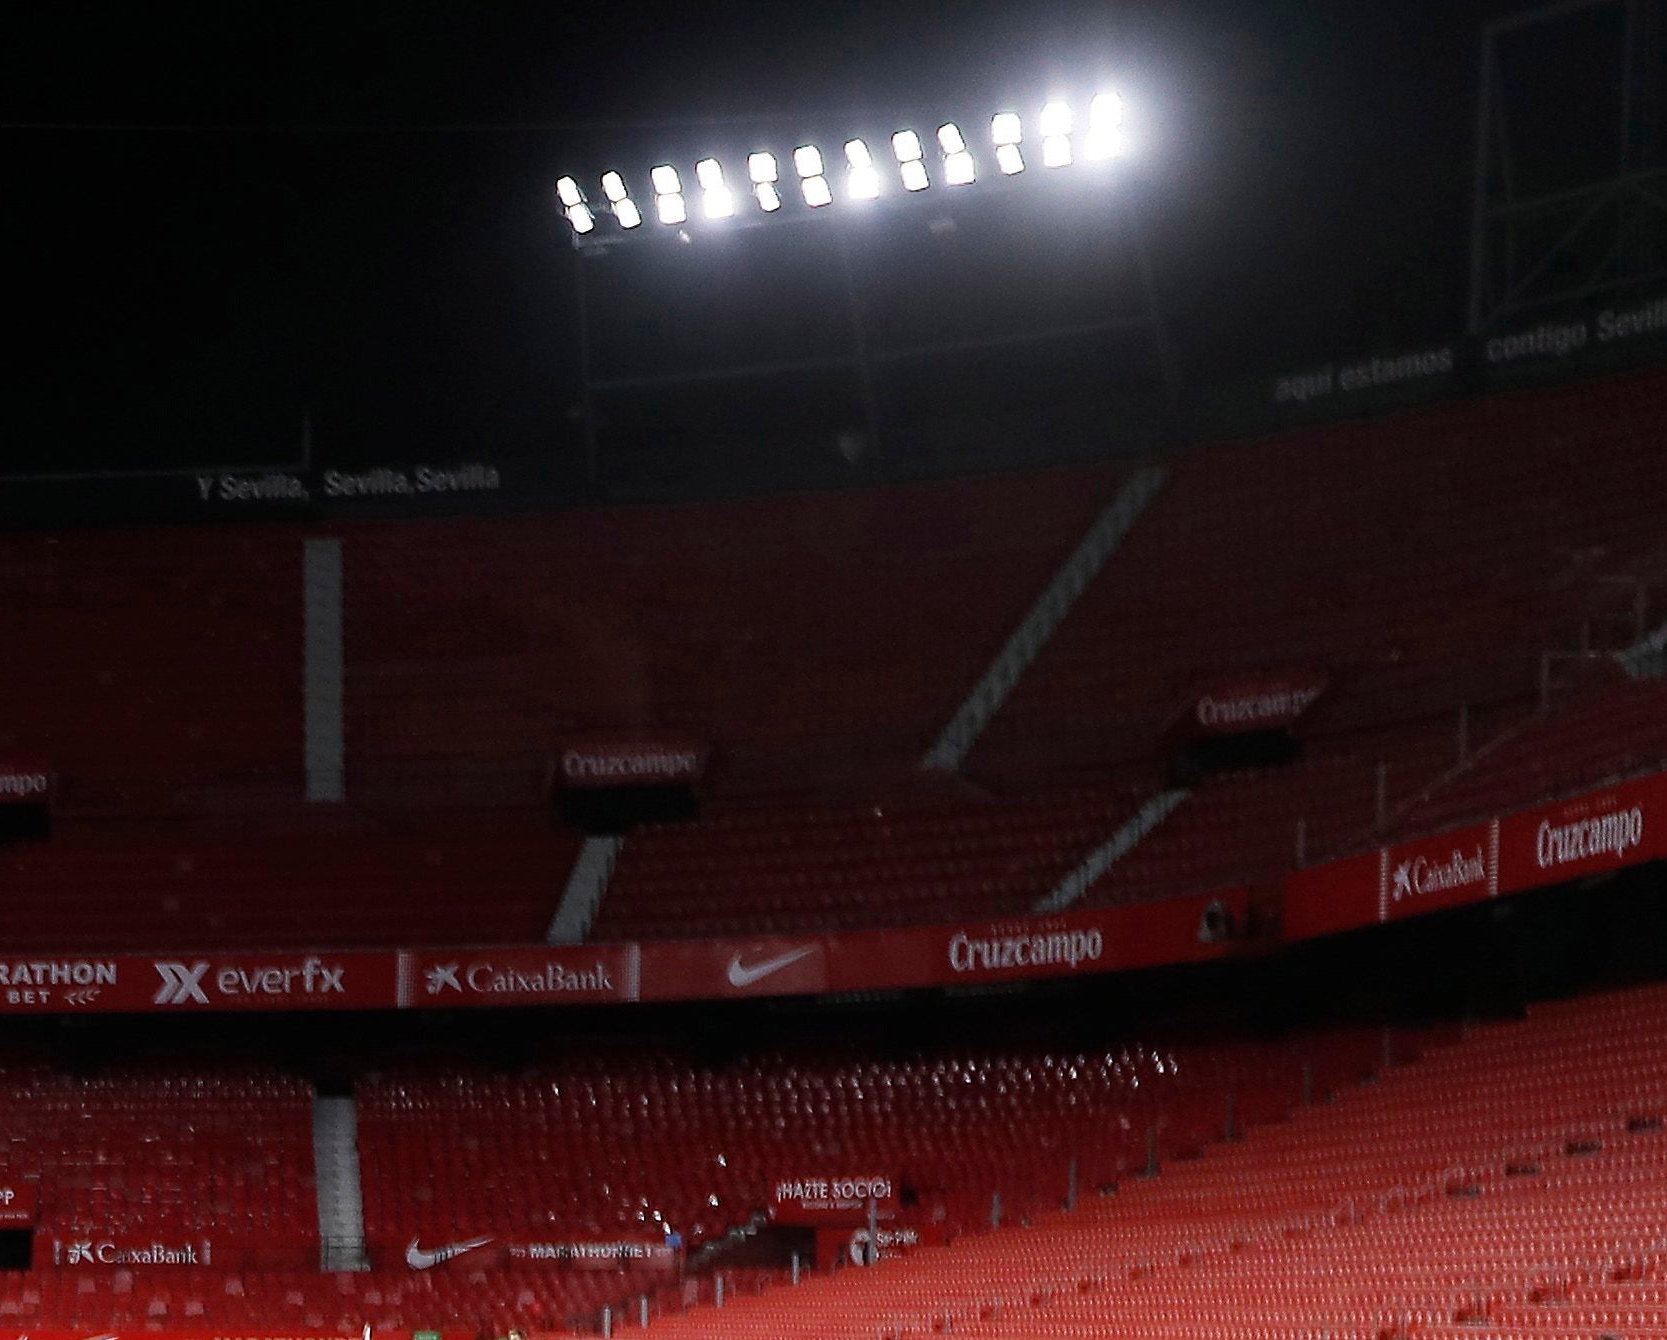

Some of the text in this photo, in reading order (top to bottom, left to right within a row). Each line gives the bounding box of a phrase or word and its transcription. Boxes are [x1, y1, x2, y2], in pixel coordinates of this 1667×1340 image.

[1536, 806, 1643, 868] Cruzcampo
[949, 928, 1103, 973] Cruzcampo
[218, 958, 345, 993] everfx
[467, 963, 614, 993] CaixaBank
[6, 991, 50, 1004] BET
